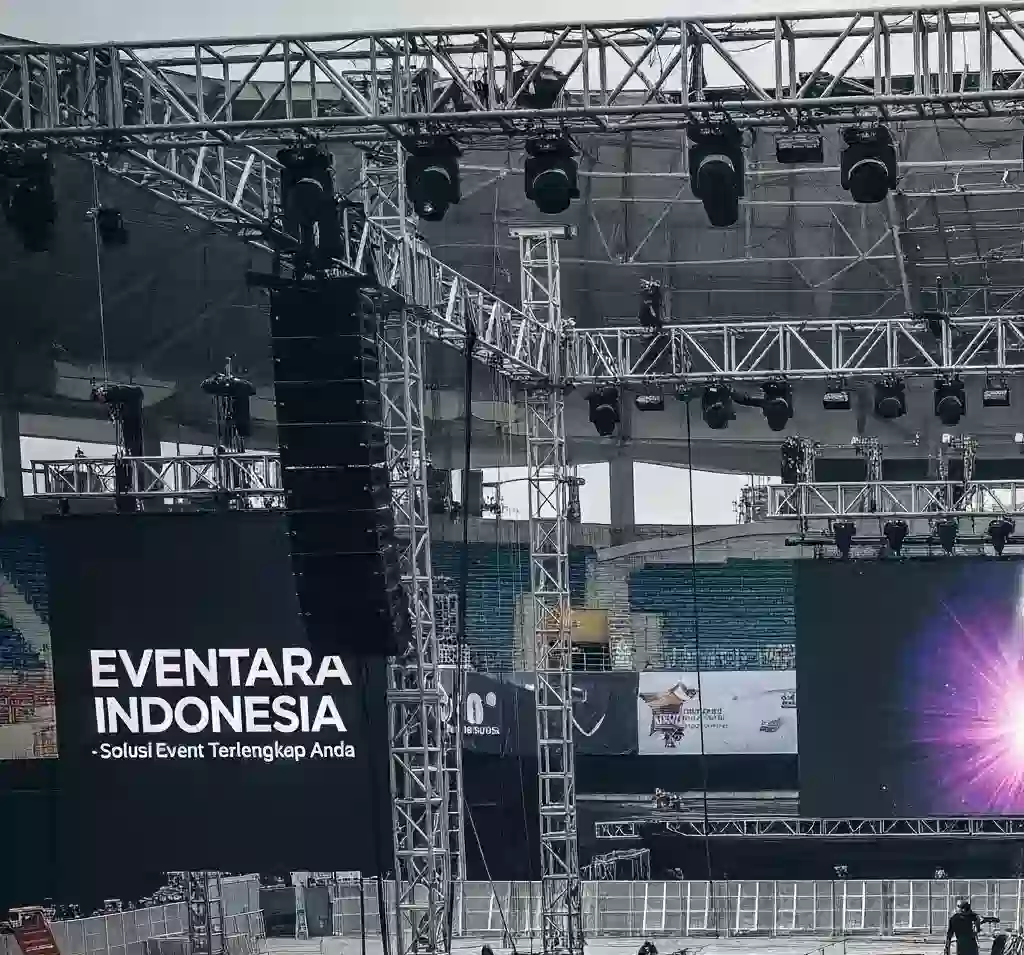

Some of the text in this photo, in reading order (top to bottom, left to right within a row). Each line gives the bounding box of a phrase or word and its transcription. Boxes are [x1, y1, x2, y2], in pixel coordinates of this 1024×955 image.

[90, 648, 353, 687] EVENTARA
[94, 695, 348, 734] INDONESIA
[156, 742, 205, 759] Event
[208, 741, 307, 762] Terlengkap
[310, 741, 356, 759] Anda
